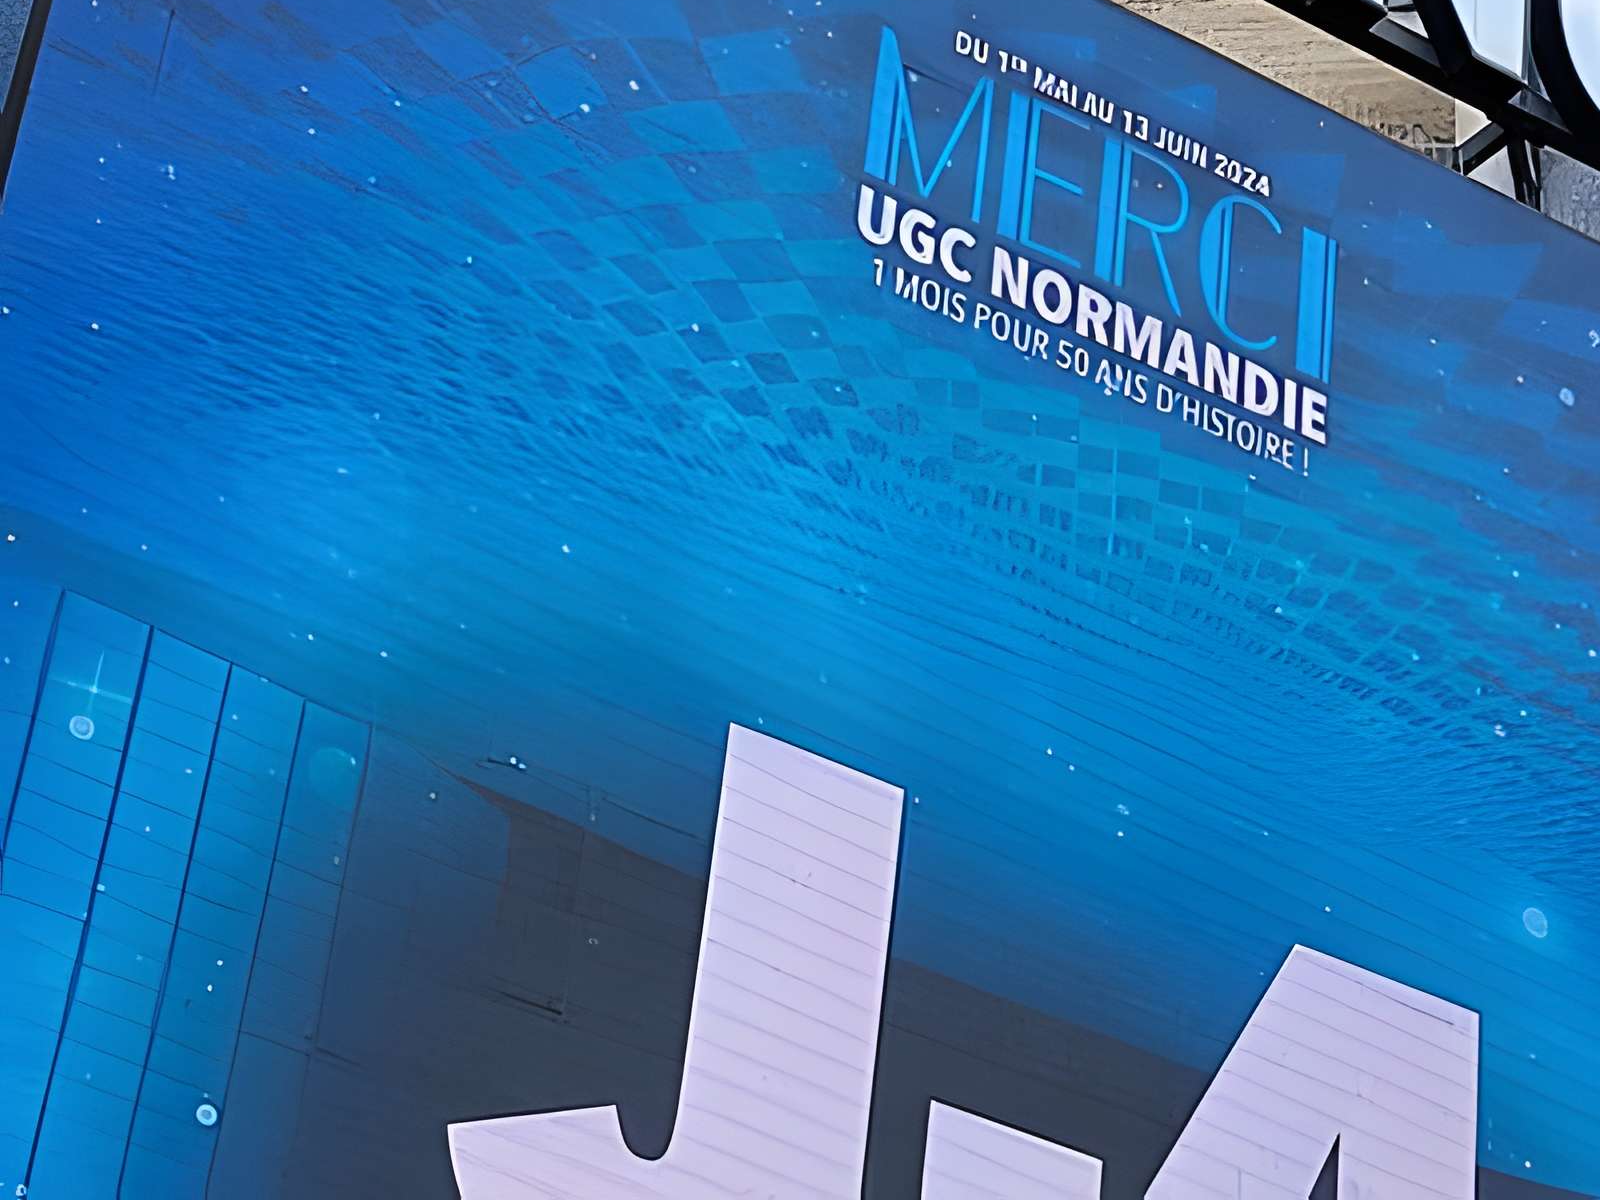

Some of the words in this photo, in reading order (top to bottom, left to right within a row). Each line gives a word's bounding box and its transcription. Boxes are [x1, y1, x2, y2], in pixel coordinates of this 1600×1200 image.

[863, 25, 1339, 385] MERCI
[955, 30, 990, 64] DU
[1033, 66, 1078, 108] MAI
[1080, 91, 1115, 124] AU
[1122, 109, 1150, 142] 13
[1153, 126, 1209, 169] JUIN
[1214, 153, 1271, 197] 2024
[856, 184, 977, 283] UGC
[990, 246, 1329, 445] NORMANDIE
[873, 258, 884, 287] 1
[895, 267, 967, 324] MOIS
[973, 302, 1049, 360] POUR
[1055, 339, 1090, 377] 50
[1095, 358, 1148, 404] ANS
[1156, 383, 1295, 470] D'HISTOIRE
